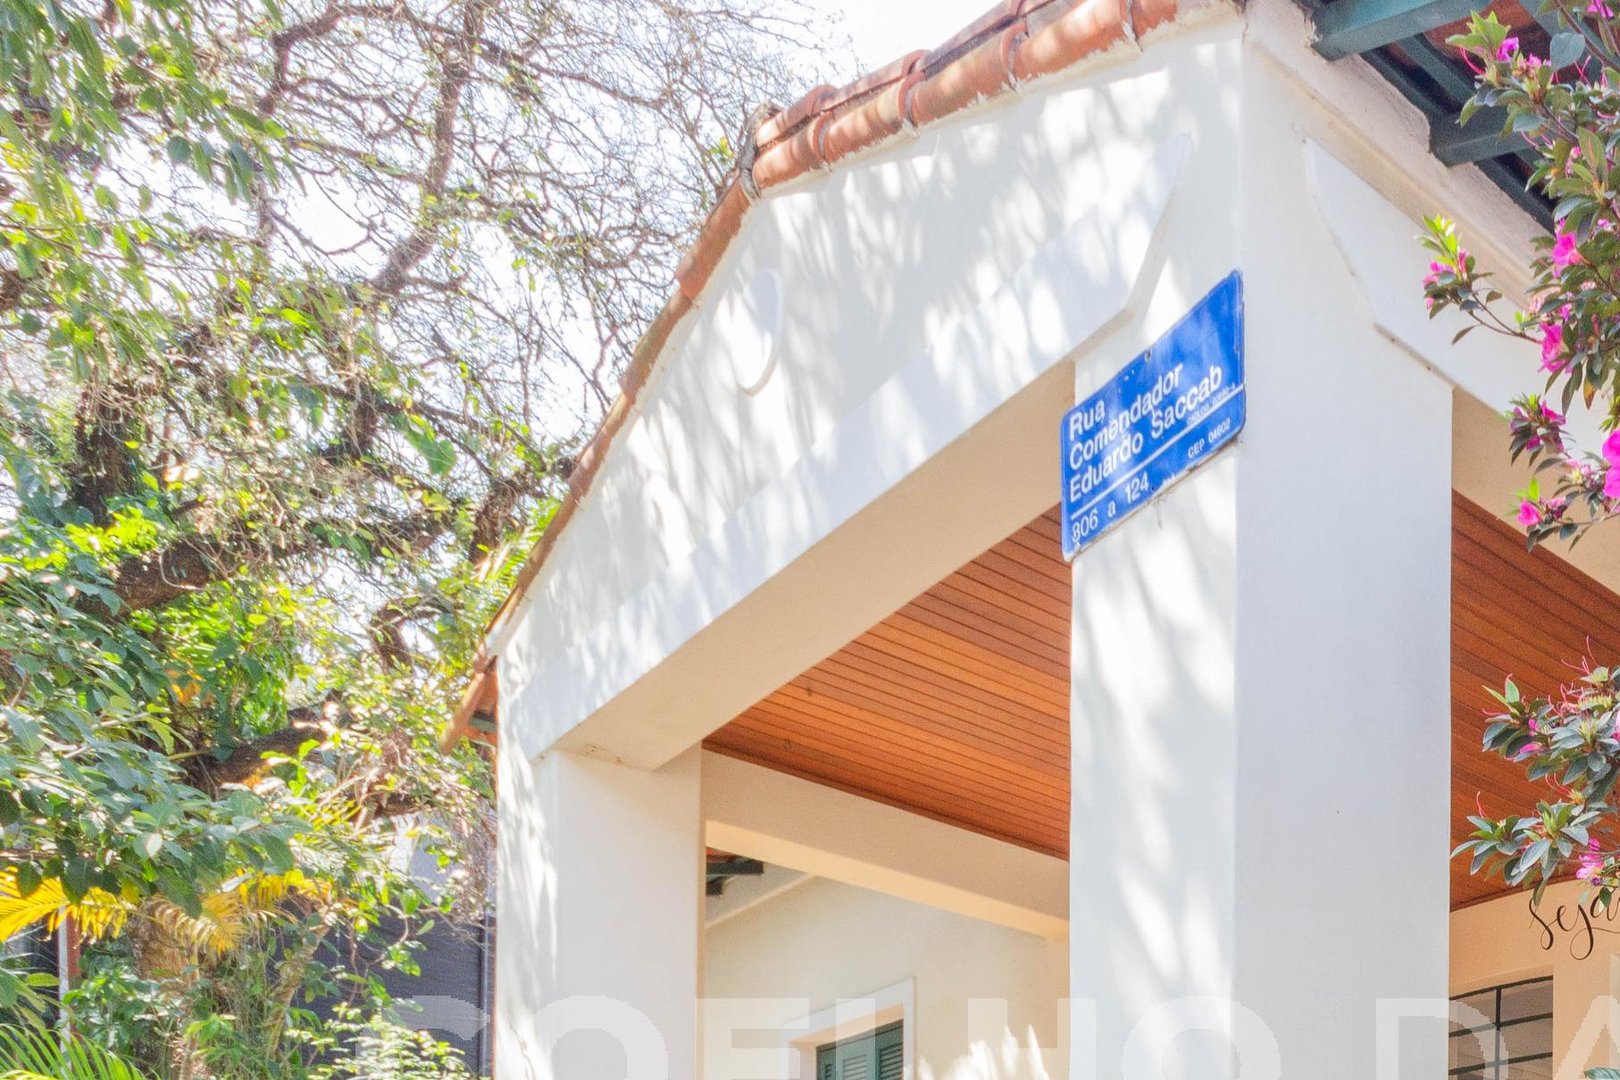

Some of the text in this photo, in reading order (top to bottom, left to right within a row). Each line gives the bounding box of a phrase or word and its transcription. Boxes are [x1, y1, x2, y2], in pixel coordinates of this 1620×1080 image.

[1070, 363, 1184, 470] Comendador
[1070, 400, 1105, 441] Rua
[1070, 432, 1144, 503] Eduardo
[1151, 365, 1222, 440] Saccab
[1188, 438, 1206, 459] CEP
[1072, 472, 1150, 542] 806 a 124
